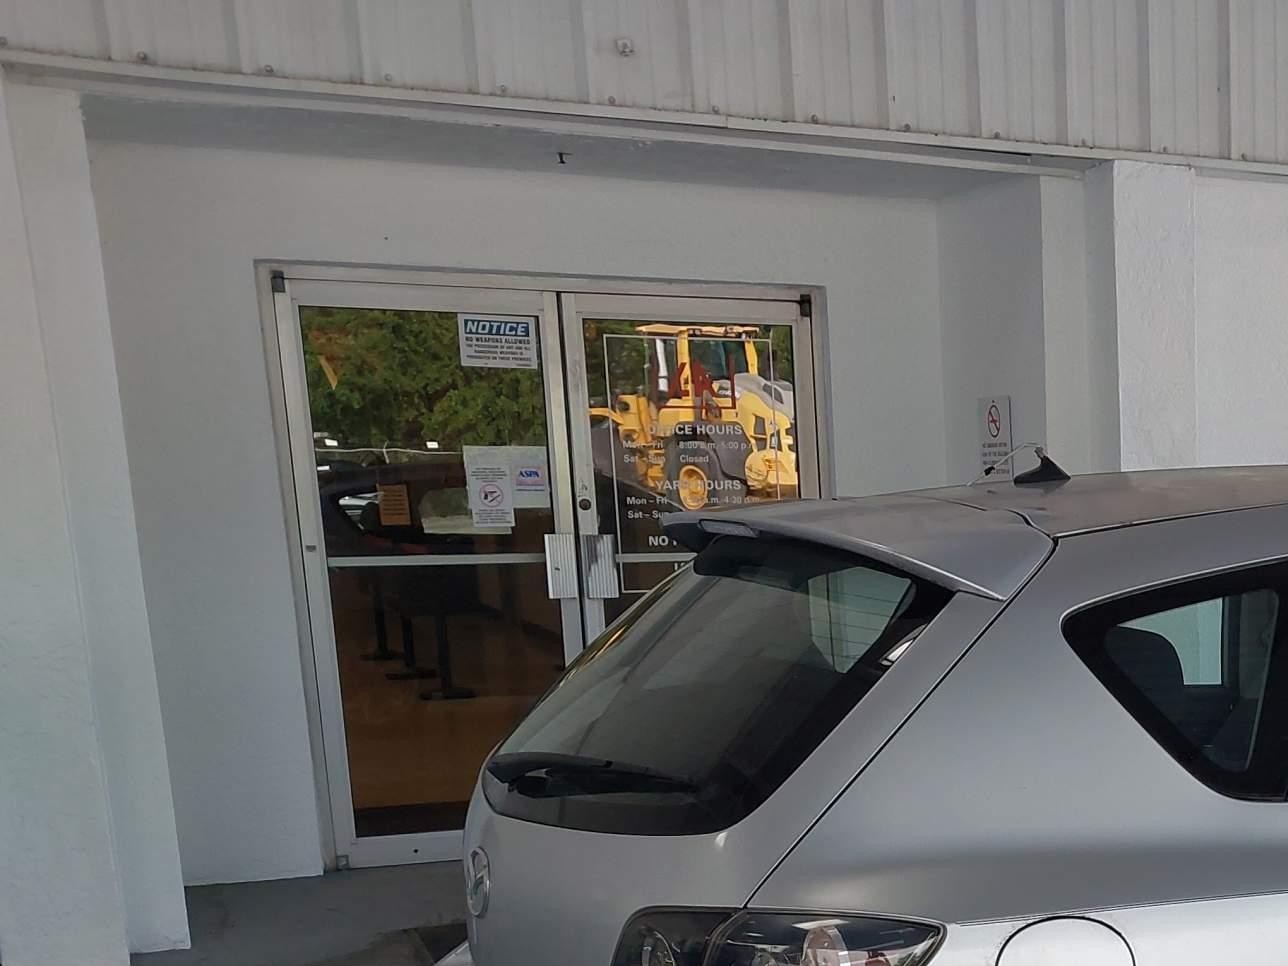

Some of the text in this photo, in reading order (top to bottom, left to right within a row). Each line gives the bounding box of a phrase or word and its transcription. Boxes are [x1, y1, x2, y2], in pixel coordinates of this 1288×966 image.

[466, 320, 528, 336] NOTICE
[697, 424, 742, 435] HOURS
[680, 454, 709, 463] Closed
[627, 496, 647, 505] Mon
[656, 495, 668, 505] Fri
[627, 510, 643, 519] Sat
[648, 535, 669, 546] NO
